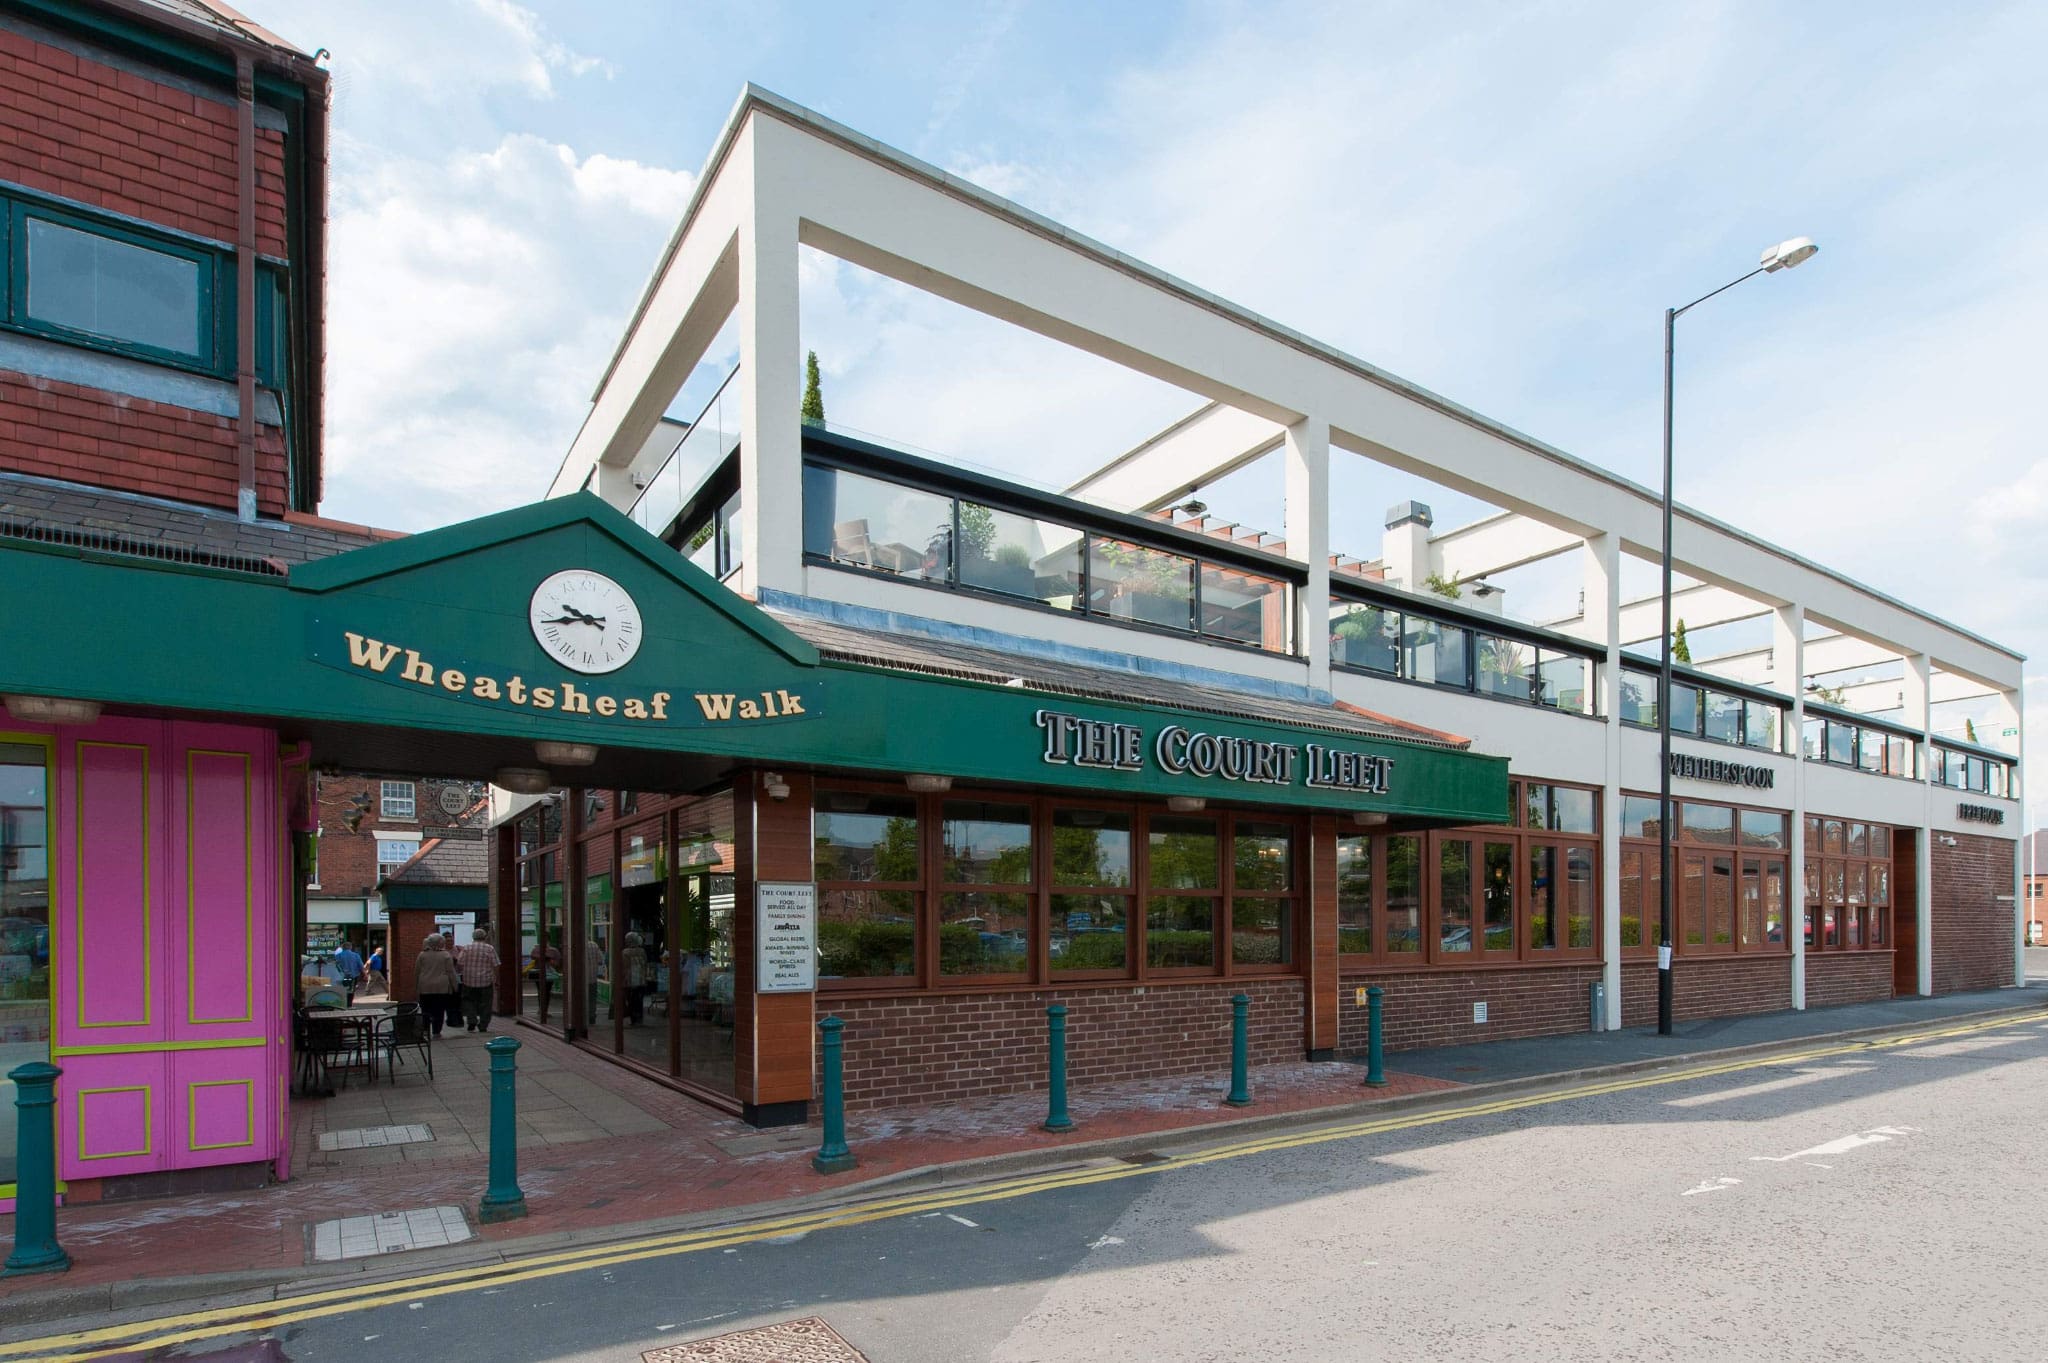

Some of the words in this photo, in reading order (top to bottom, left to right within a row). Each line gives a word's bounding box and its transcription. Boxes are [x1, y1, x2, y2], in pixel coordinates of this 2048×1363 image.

[344, 631, 671, 721] Wheatsheaf
[694, 689, 806, 721] Walk
[1036, 709, 1145, 772] THE
[1156, 724, 1298, 785] COURT
[1305, 743, 1395, 794] LEET
[1669, 752, 1775, 789] WETHERSPOON
